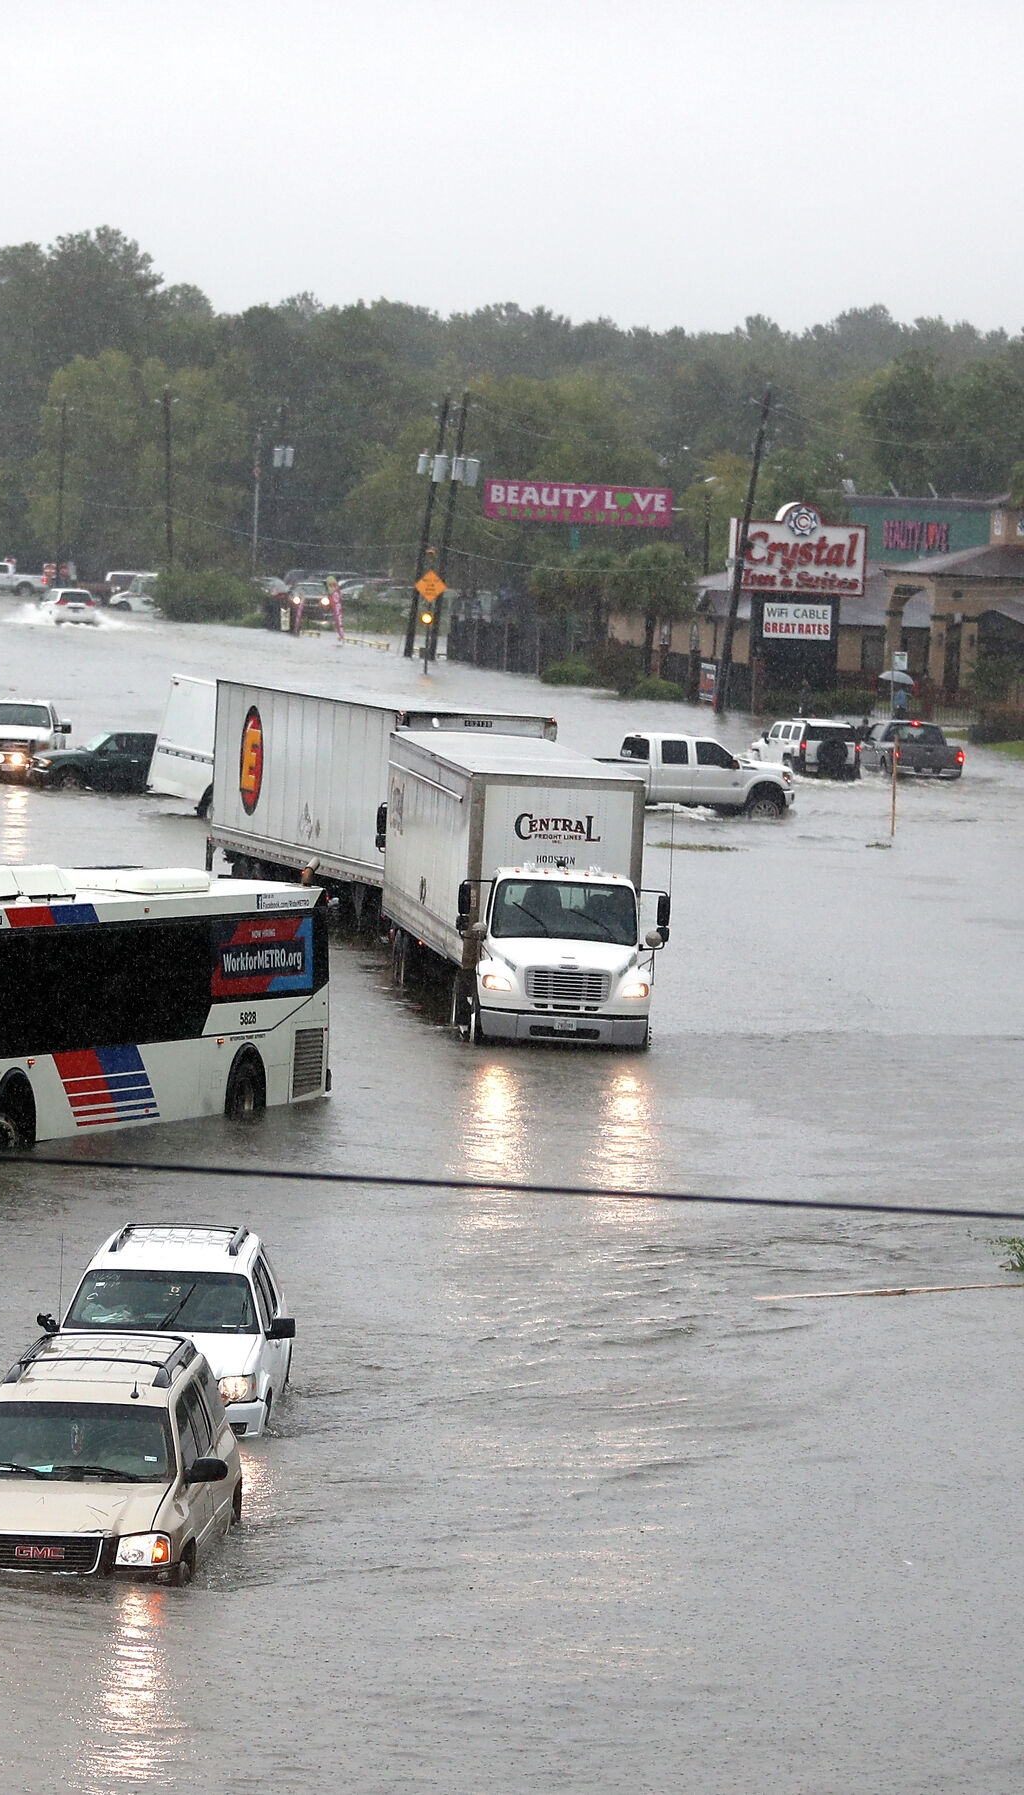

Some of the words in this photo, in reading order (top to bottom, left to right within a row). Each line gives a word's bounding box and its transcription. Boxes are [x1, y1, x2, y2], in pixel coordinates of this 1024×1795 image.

[491, 484, 598, 508] BEAUTY
[498, 506, 573, 520] BEAUTY
[584, 510, 657, 524] SUPPLY
[745, 531, 859, 571] Crystal
[742, 568, 777, 587] Inn
[796, 571, 859, 591] Suites
[793, 608, 828, 620] CABLE
[764, 622, 797, 635] GREAT
[798, 623, 830, 636] RATES
[514, 812, 601, 842] CENTRAL
[536, 855, 576, 865] HOUSTON
[251, 931, 262, 939] NOW
[262, 928, 276, 937] HIRING
[223, 948, 303, 973] WorkforMETRO.org
[240, 1011, 256, 1025] 5828
[15, 1546, 65, 1560] GMC
